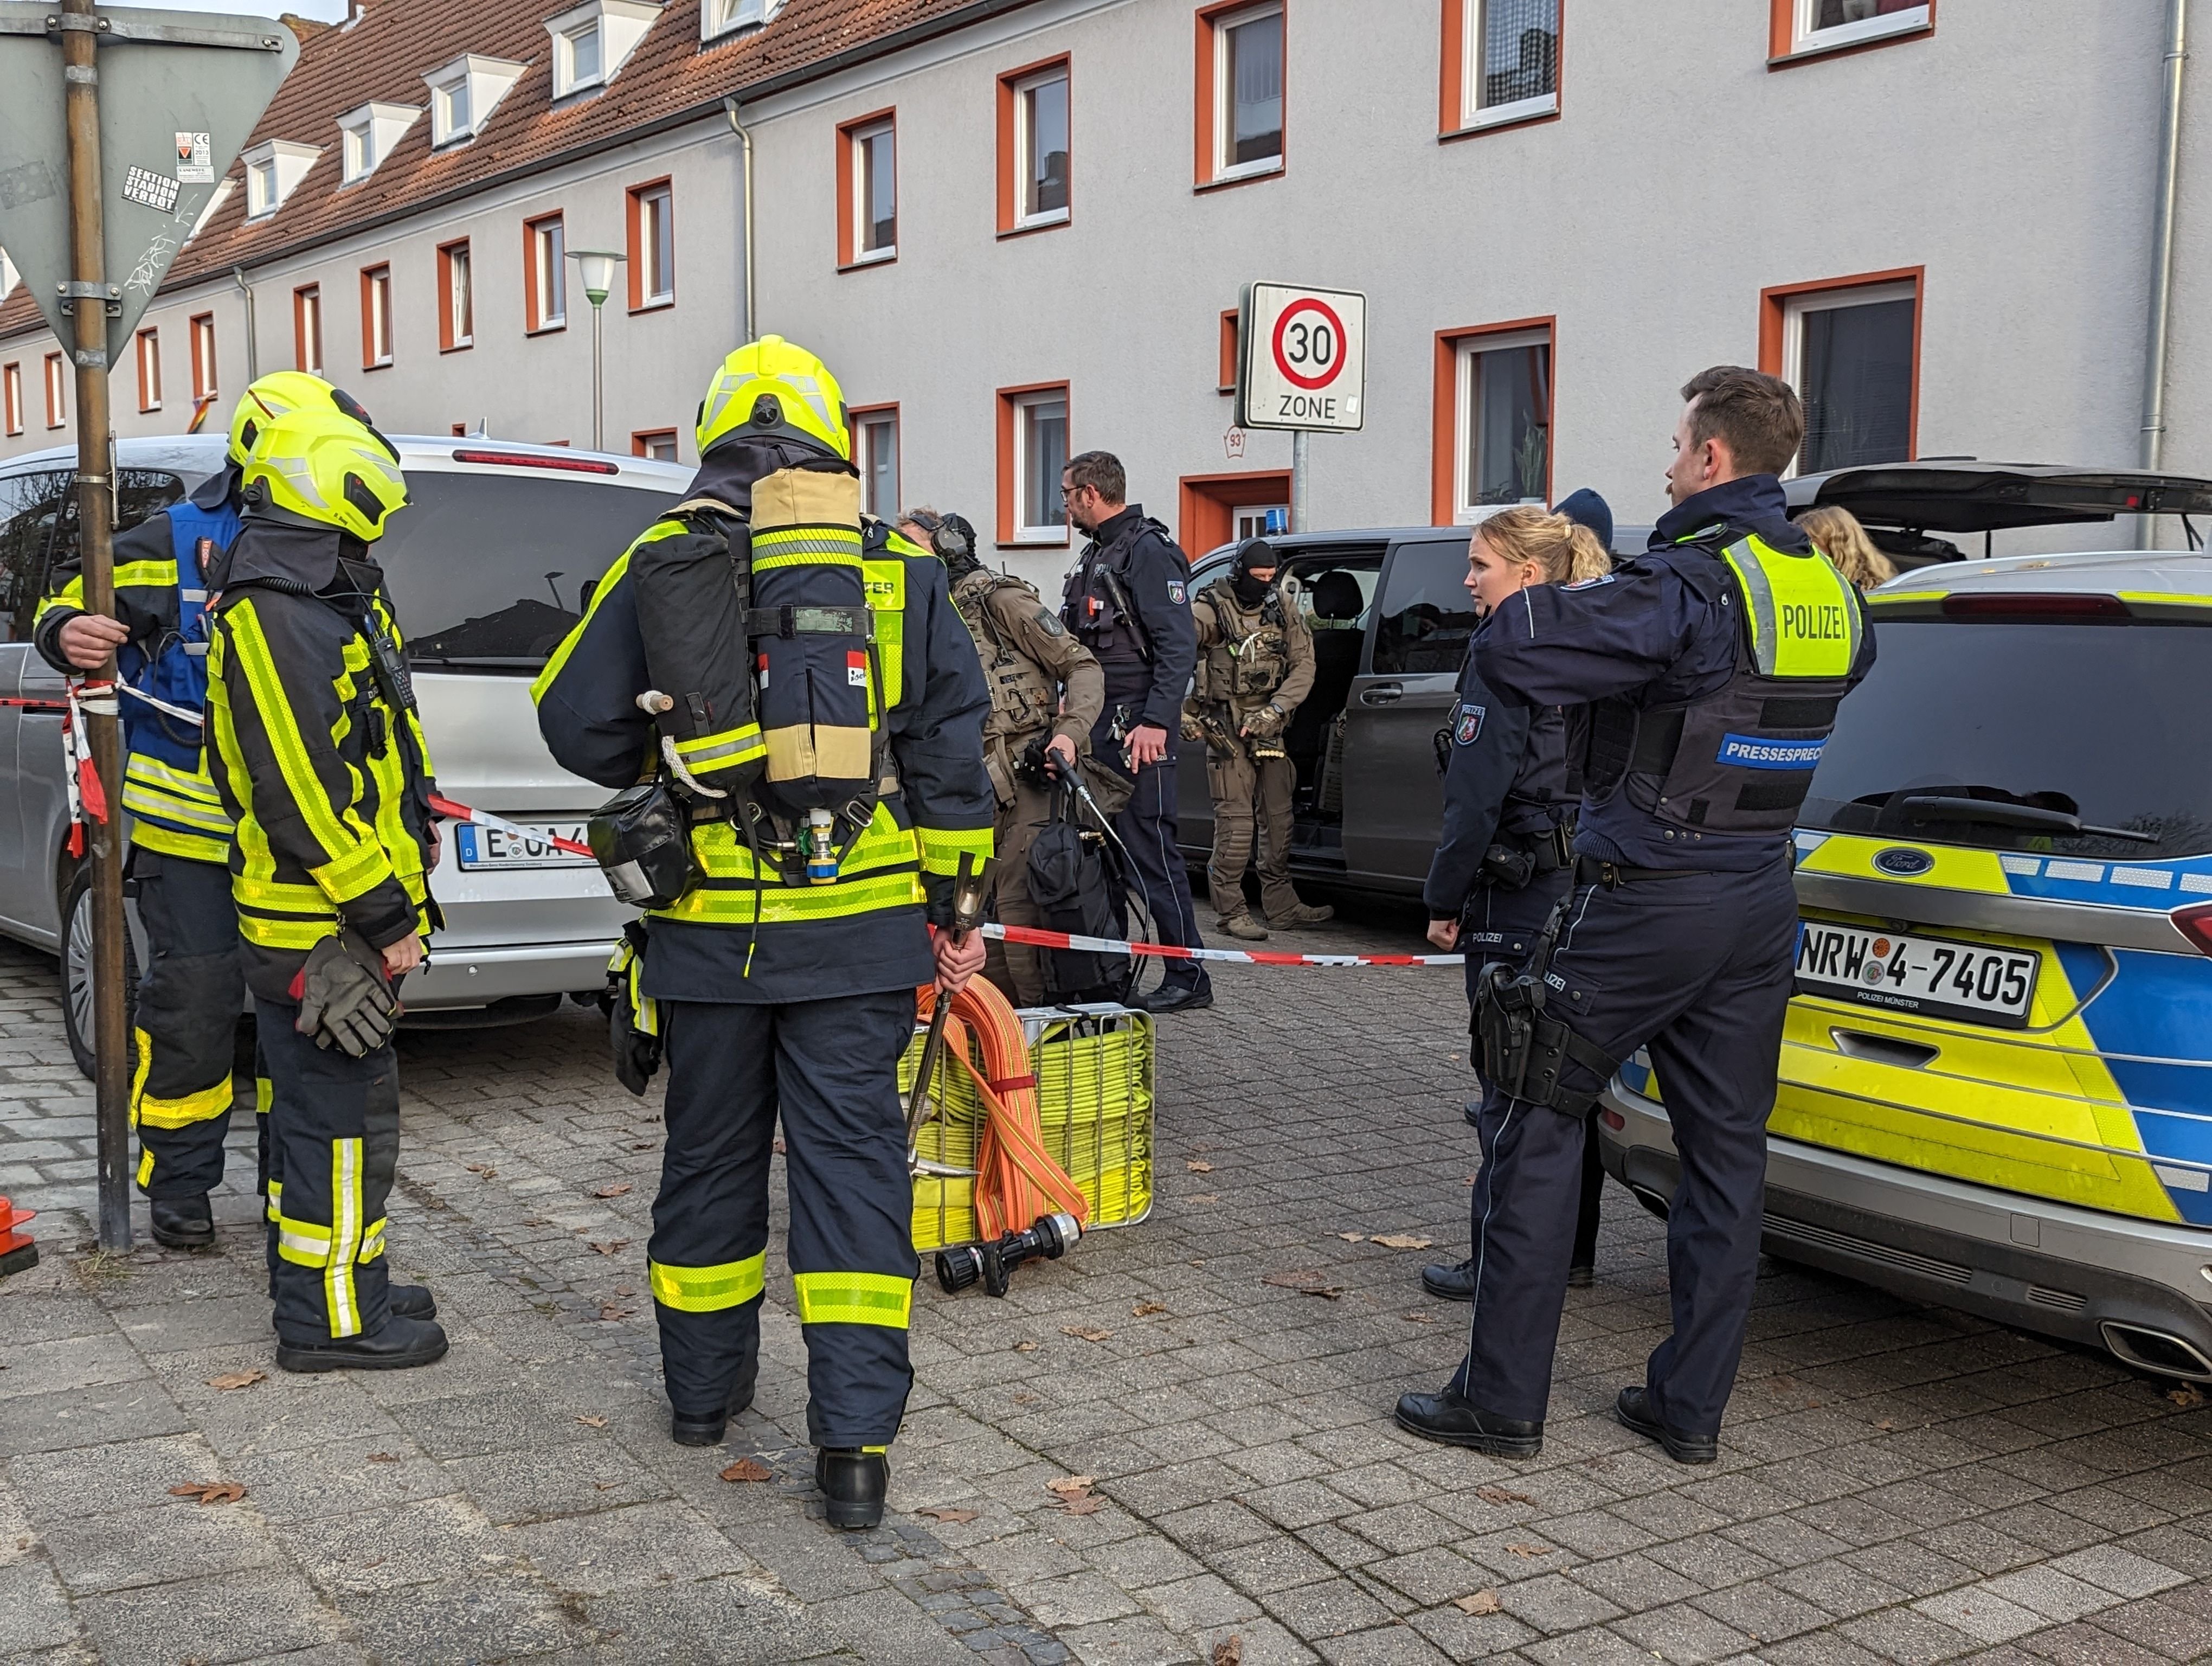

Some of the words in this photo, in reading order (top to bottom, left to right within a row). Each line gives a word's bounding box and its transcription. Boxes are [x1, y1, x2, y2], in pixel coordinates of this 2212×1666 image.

[194, 134, 209, 145] CE
[126, 175, 177, 200] STADION
[128, 166, 180, 190] SEKTION
[124, 184, 175, 209] VERBOT
[1288, 323, 1331, 366] 30
[1279, 395, 1336, 419] ZONE
[1230, 433, 1242, 447] 93
[864, 582, 894, 594] TER
[1782, 605, 1845, 639] POLIZEI
[1726, 742, 1823, 761] PRESSESPREC
[466, 848, 473, 857] D
[486, 829, 507, 857] E
[1886, 854, 1920, 869] Ford
[1472, 932, 1503, 943] POLIZEI
[1796, 928, 1869, 979] NRW
[1887, 943, 2030, 1005] 4-7405
[1544, 971, 1566, 991] LIZEI
[1857, 991, 1883, 1002] POLIZEI
[1884, 996, 1919, 1009] MÜNSTER
